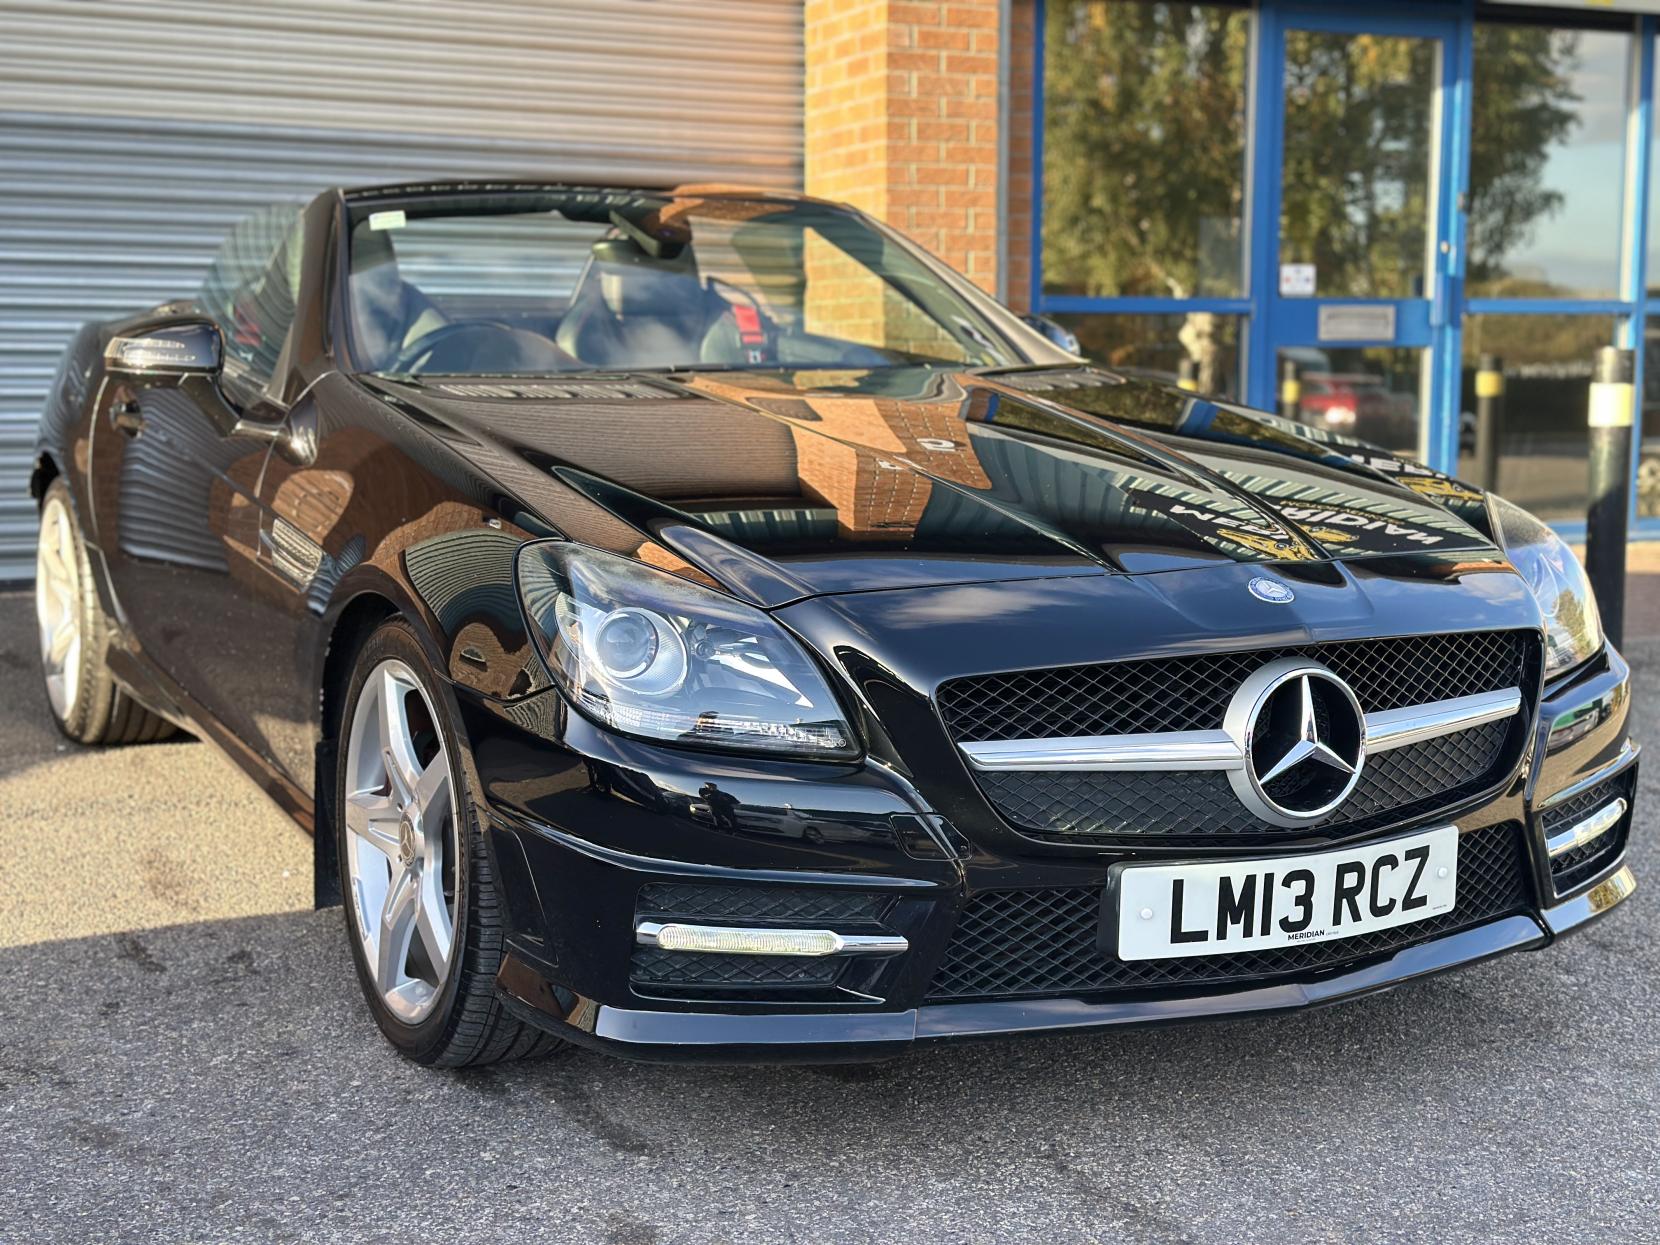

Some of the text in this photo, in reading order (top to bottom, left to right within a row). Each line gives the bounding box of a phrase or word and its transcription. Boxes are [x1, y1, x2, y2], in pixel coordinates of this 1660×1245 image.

[1169, 844, 1431, 945] LM13 RCZ
[1287, 929, 1325, 941] MERIDIAN
